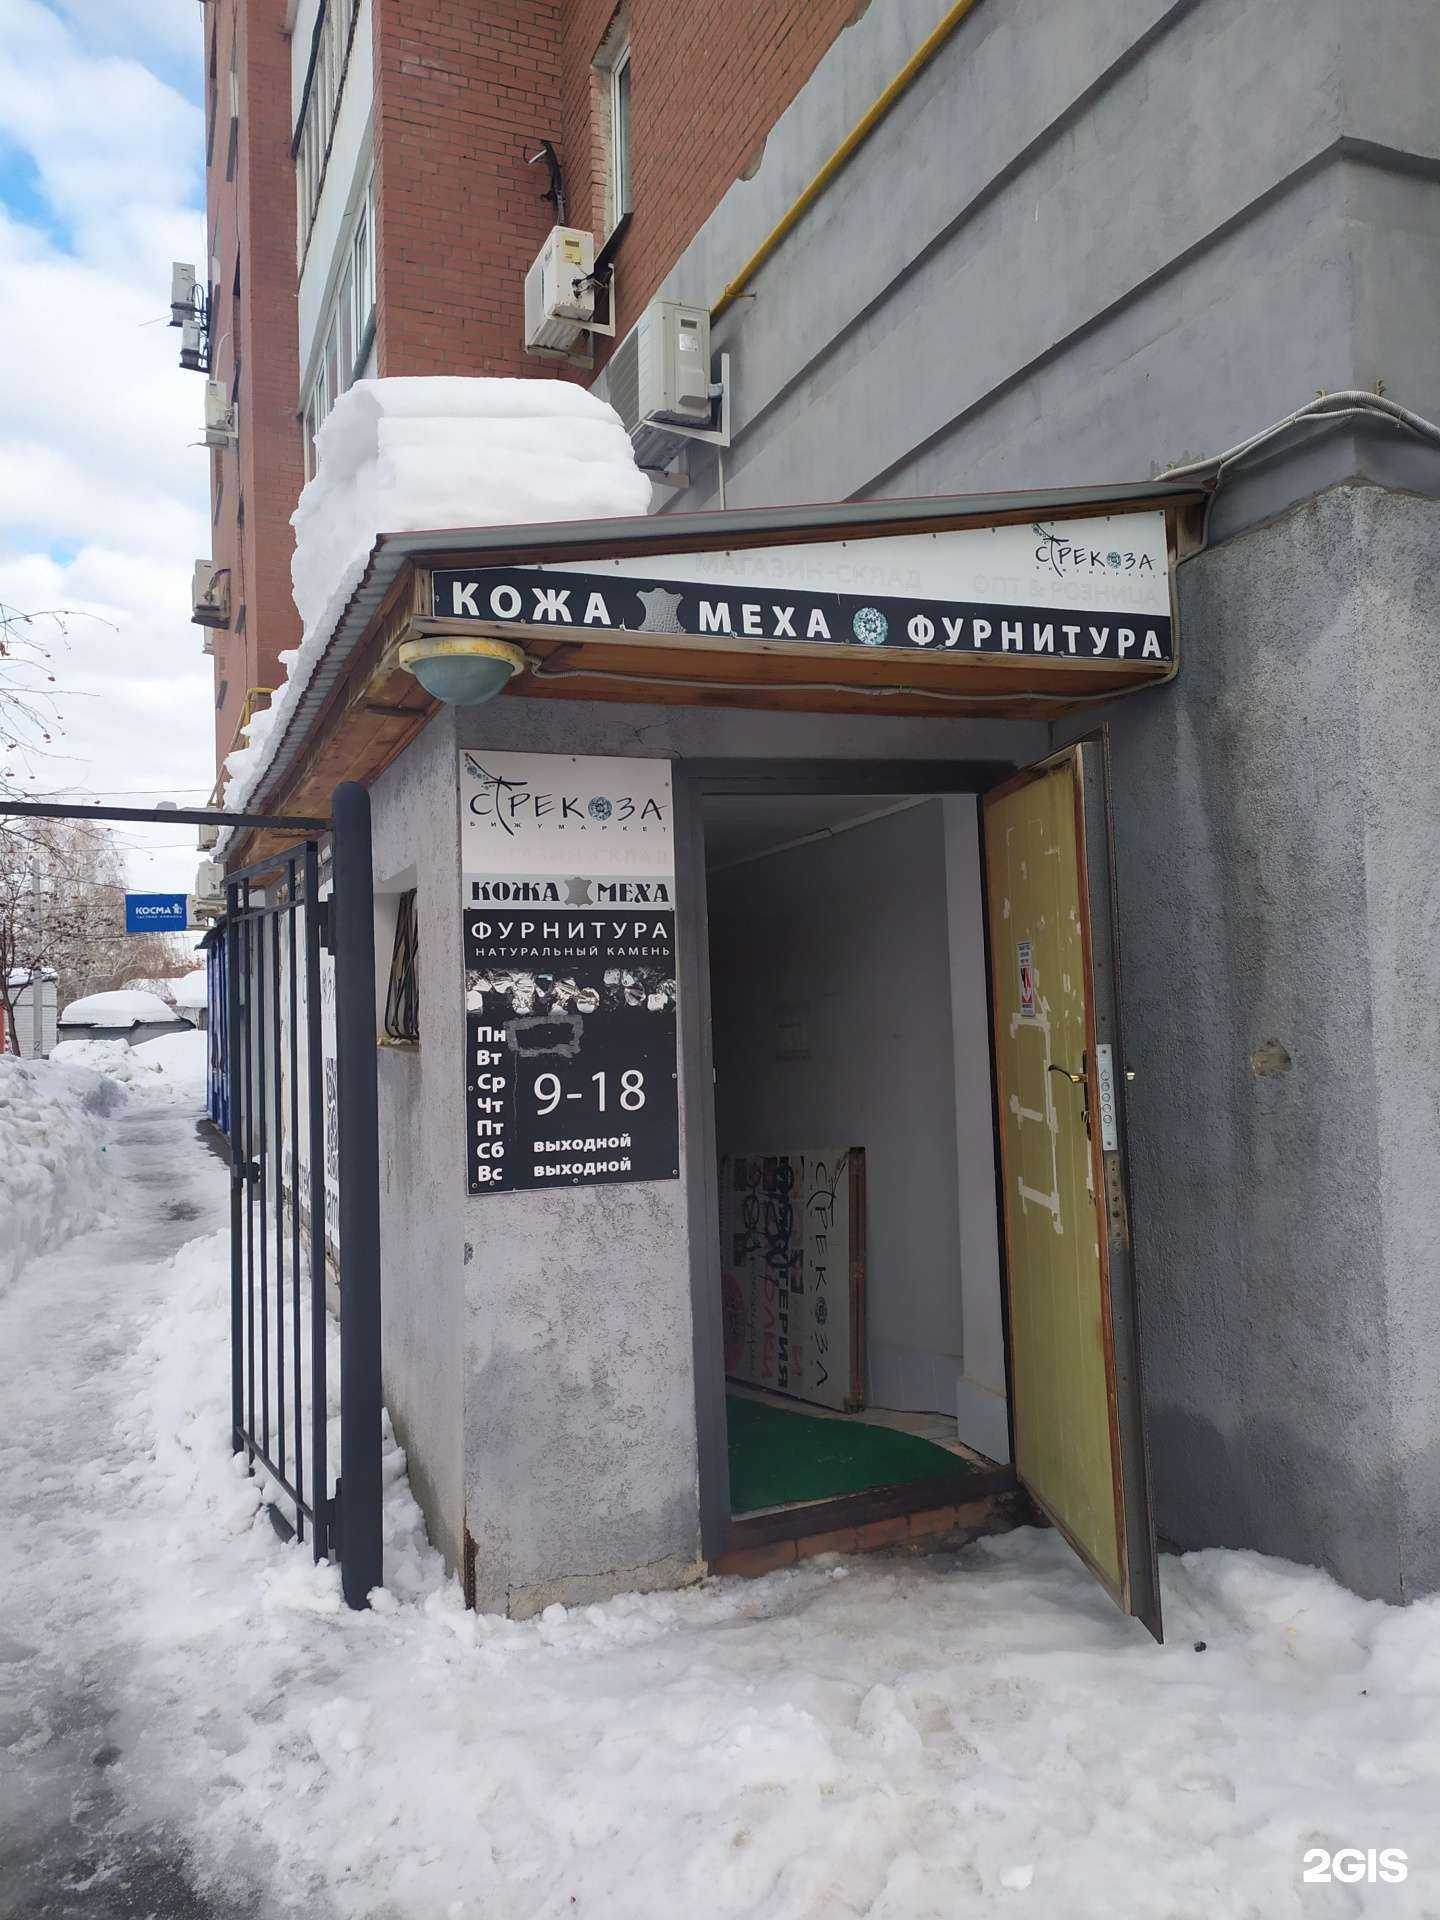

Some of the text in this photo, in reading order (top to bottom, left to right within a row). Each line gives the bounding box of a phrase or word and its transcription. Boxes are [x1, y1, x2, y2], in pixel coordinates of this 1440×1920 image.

[1034, 524, 1156, 577] СТРЕКОЗА
[452, 581, 1162, 659] КОЖА МЕХА ФУРНИТУРА
[468, 764, 668, 835] СТРЕКОЗА
[469, 821, 668, 832] БИЖУМАРКЕТ
[471, 880, 670, 903] КОЖА МЕХА
[135, 906, 171, 915] КОСМА
[471, 921, 668, 940] ФУРНИТУРА
[475, 945, 670, 957] НАТУРАЛЬНЫЙ КАМЕНЬ
[477, 1026, 507, 1043] Пн
[476, 1049, 503, 1066] Вт
[477, 1073, 506, 1093] Ср
[533, 1069, 647, 1116] 9-18
[477, 1097, 504, 1114] Чт
[477, 1119, 504, 1137] Пт
[476, 1133, 632, 1159] Сб выходной
[477, 1157, 632, 1182] Вс выходной
